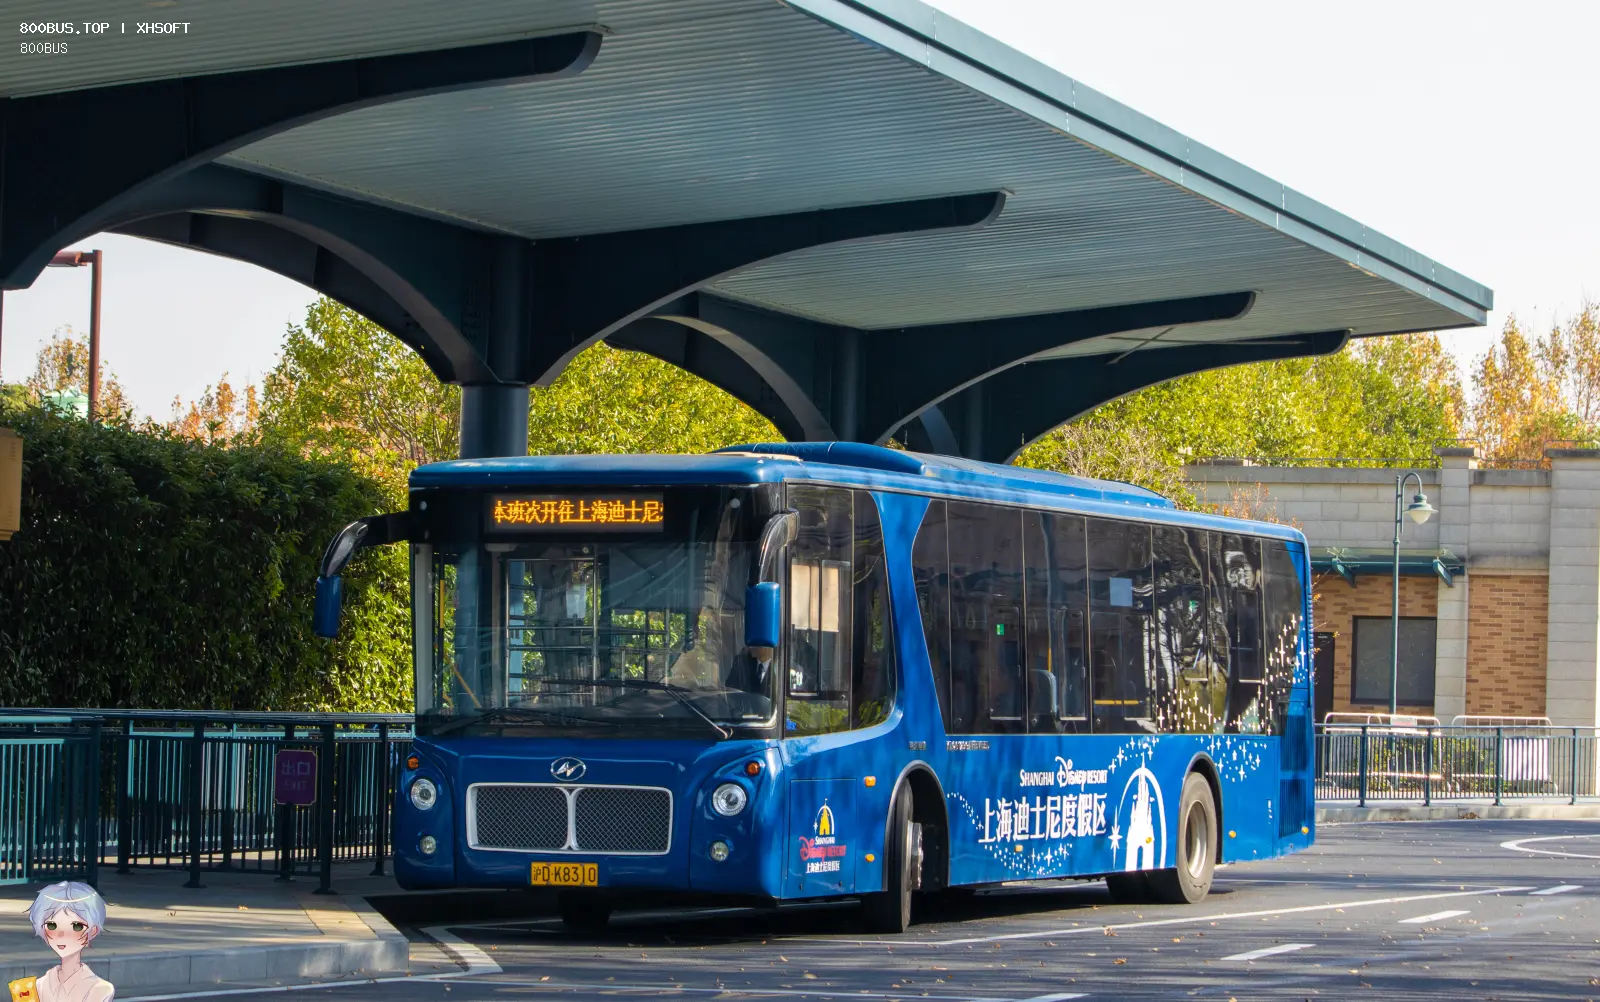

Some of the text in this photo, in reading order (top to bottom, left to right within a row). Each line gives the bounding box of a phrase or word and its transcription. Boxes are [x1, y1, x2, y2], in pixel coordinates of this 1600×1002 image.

[494, 500, 664, 523] 本班次开往上海迪士尼
[281, 759, 310, 776] 出口
[1019, 768, 1055, 787] SHANGHAI
[978, 793, 1108, 843] 上海迪士尼度假区
